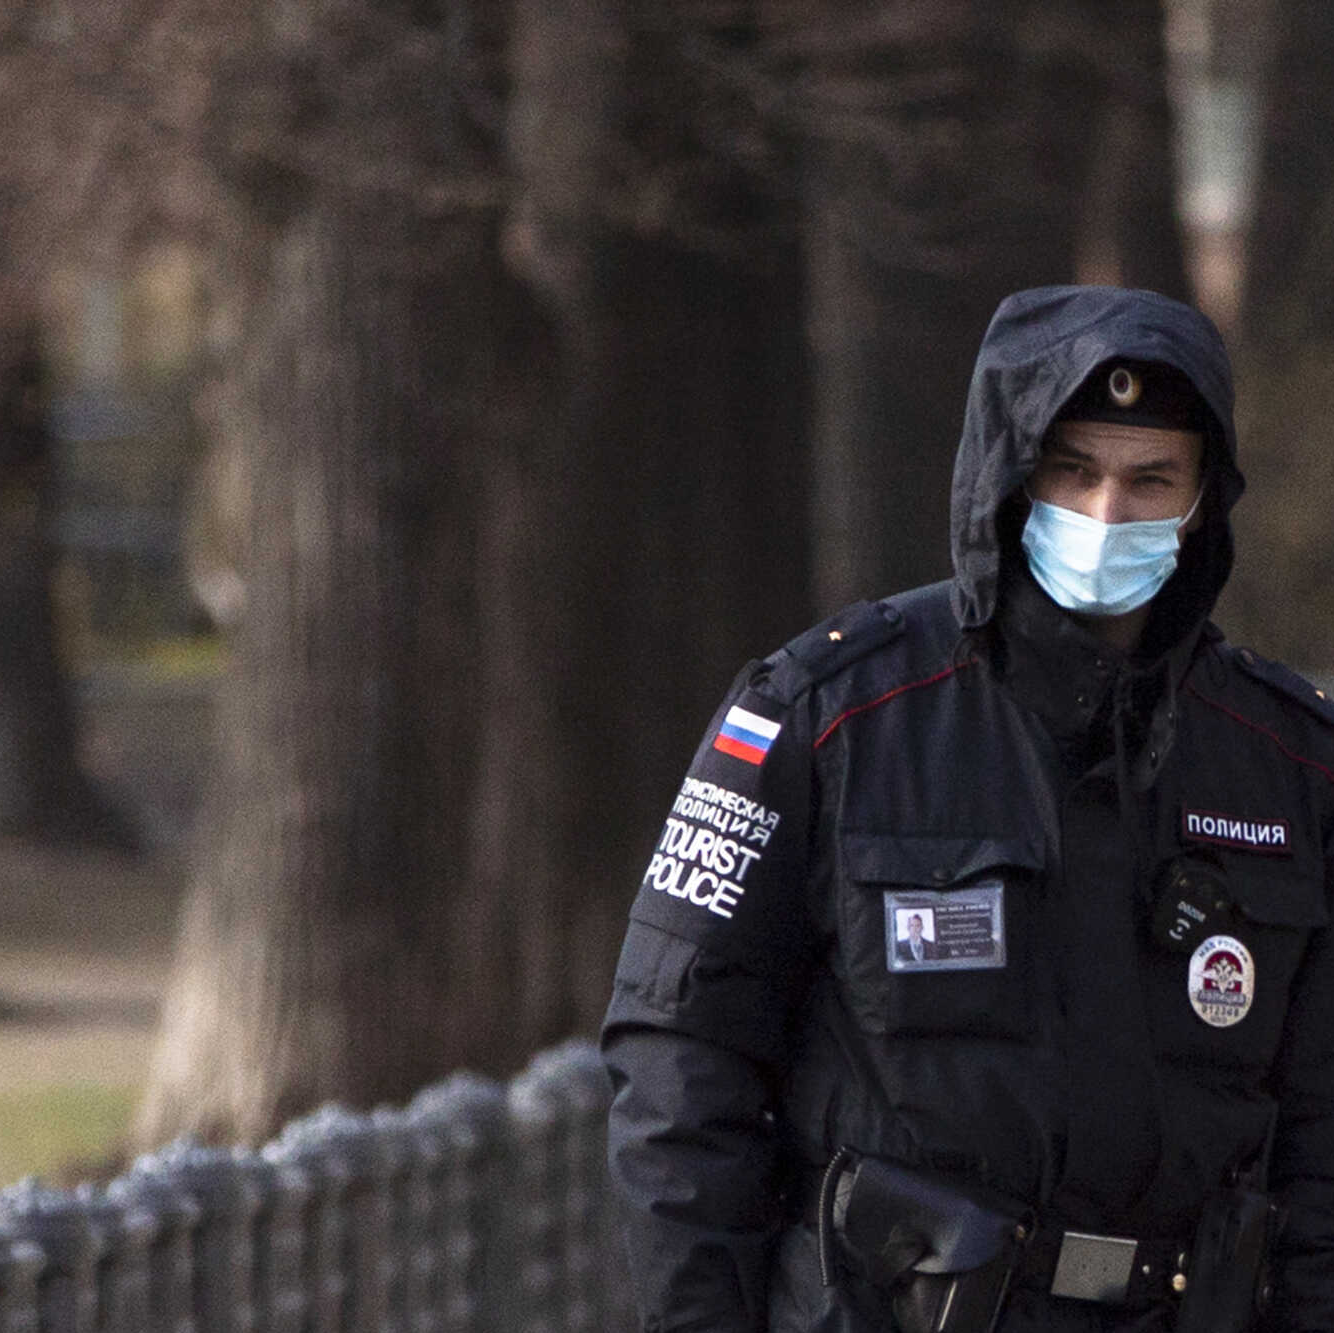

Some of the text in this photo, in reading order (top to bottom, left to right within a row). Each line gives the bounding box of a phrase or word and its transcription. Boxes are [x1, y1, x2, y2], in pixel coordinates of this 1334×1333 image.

[659, 817, 761, 881] TOURIST
[672, 795, 772, 848] ПОЛИЦИЯ
[1187, 814, 1286, 845] ПОЛИЦИЯ
[642, 853, 745, 919] POLICE
